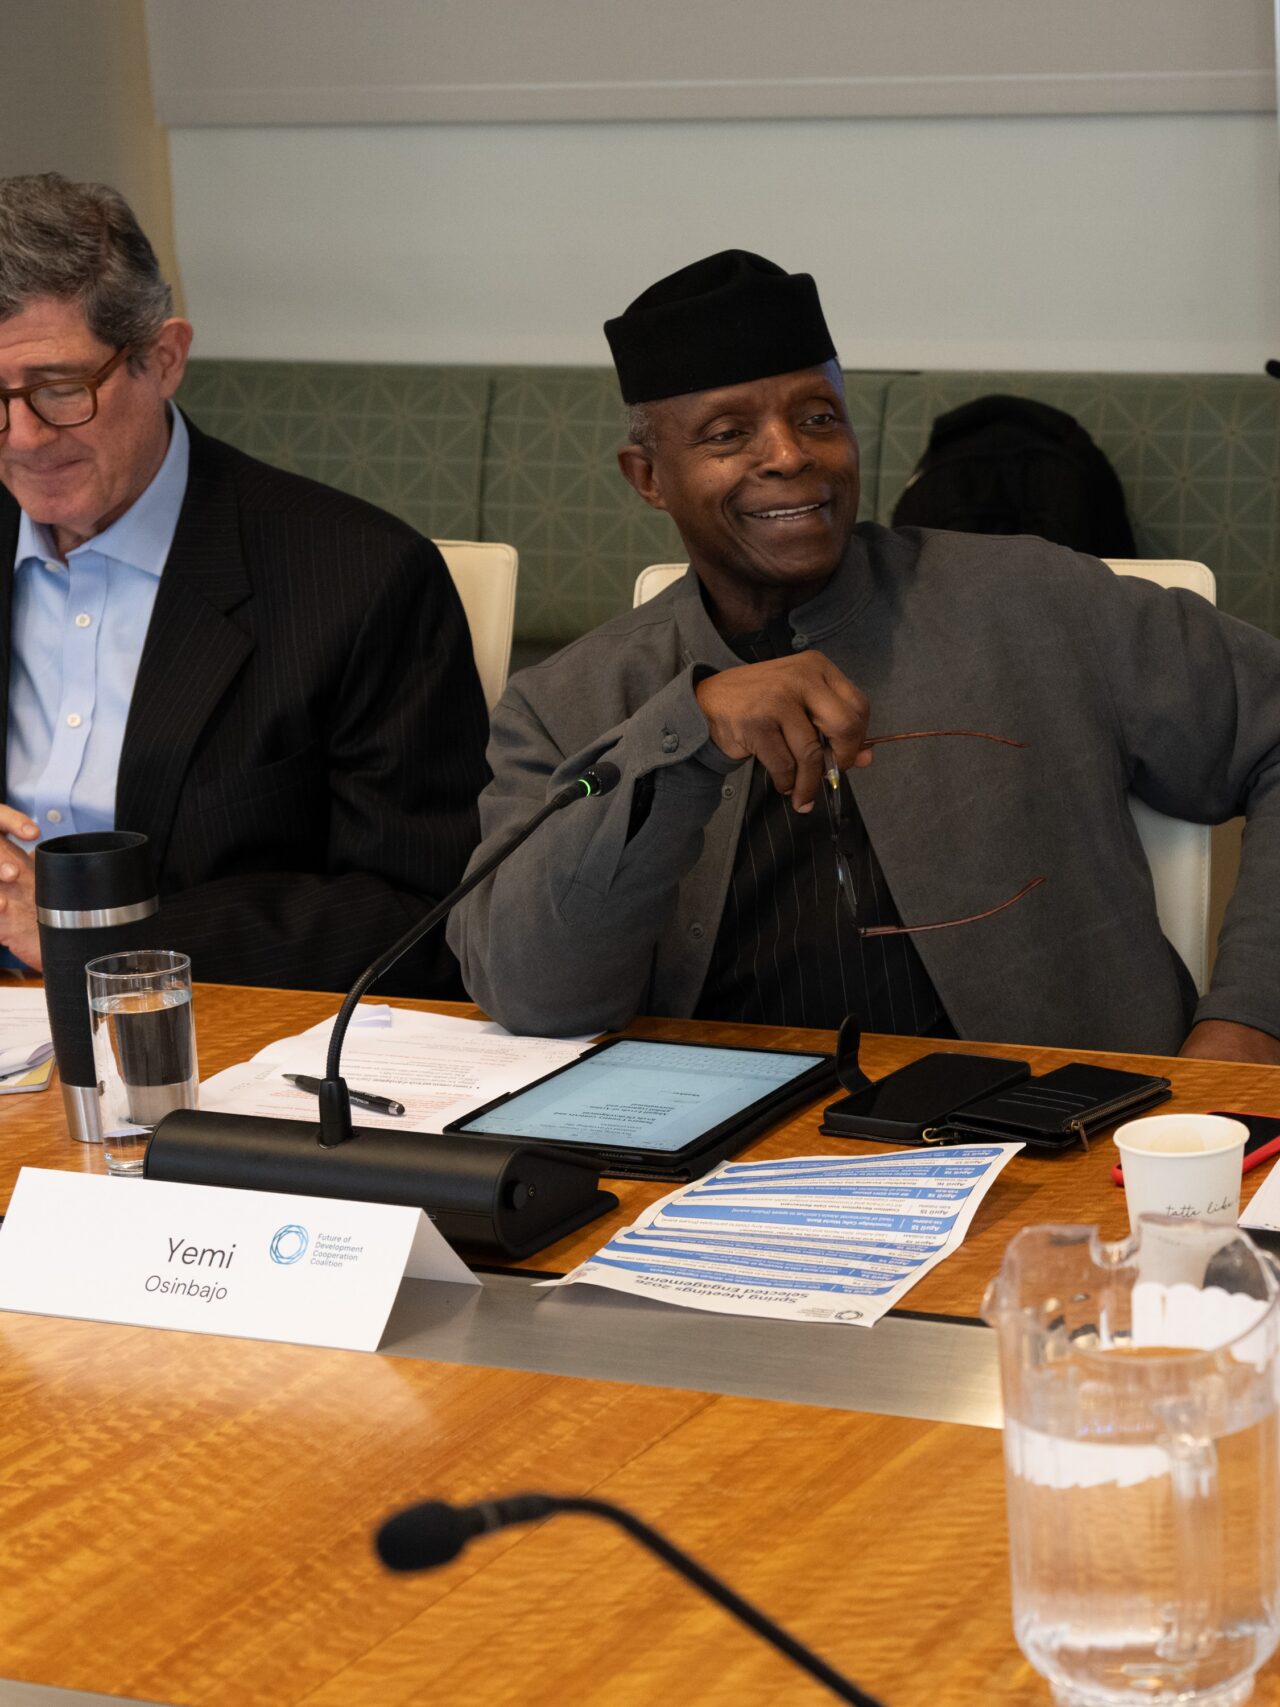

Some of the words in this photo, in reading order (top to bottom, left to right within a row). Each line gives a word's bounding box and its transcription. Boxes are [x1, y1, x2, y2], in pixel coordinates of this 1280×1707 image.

[1206, 1196, 1233, 1214] like
[318, 1233, 342, 1243] Future
[315, 1241, 364, 1252] Development
[167, 1237, 237, 1269] Yemi
[313, 1250, 358, 1261] Cooperation
[310, 1257, 343, 1268] Coalition
[144, 1274, 228, 1304] Osinbajo
[636, 1275, 740, 1292] Engagements
[674, 1286, 744, 1300] Meetings
[743, 1288, 810, 1298] Selected
[748, 1294, 798, 1304] Spring
